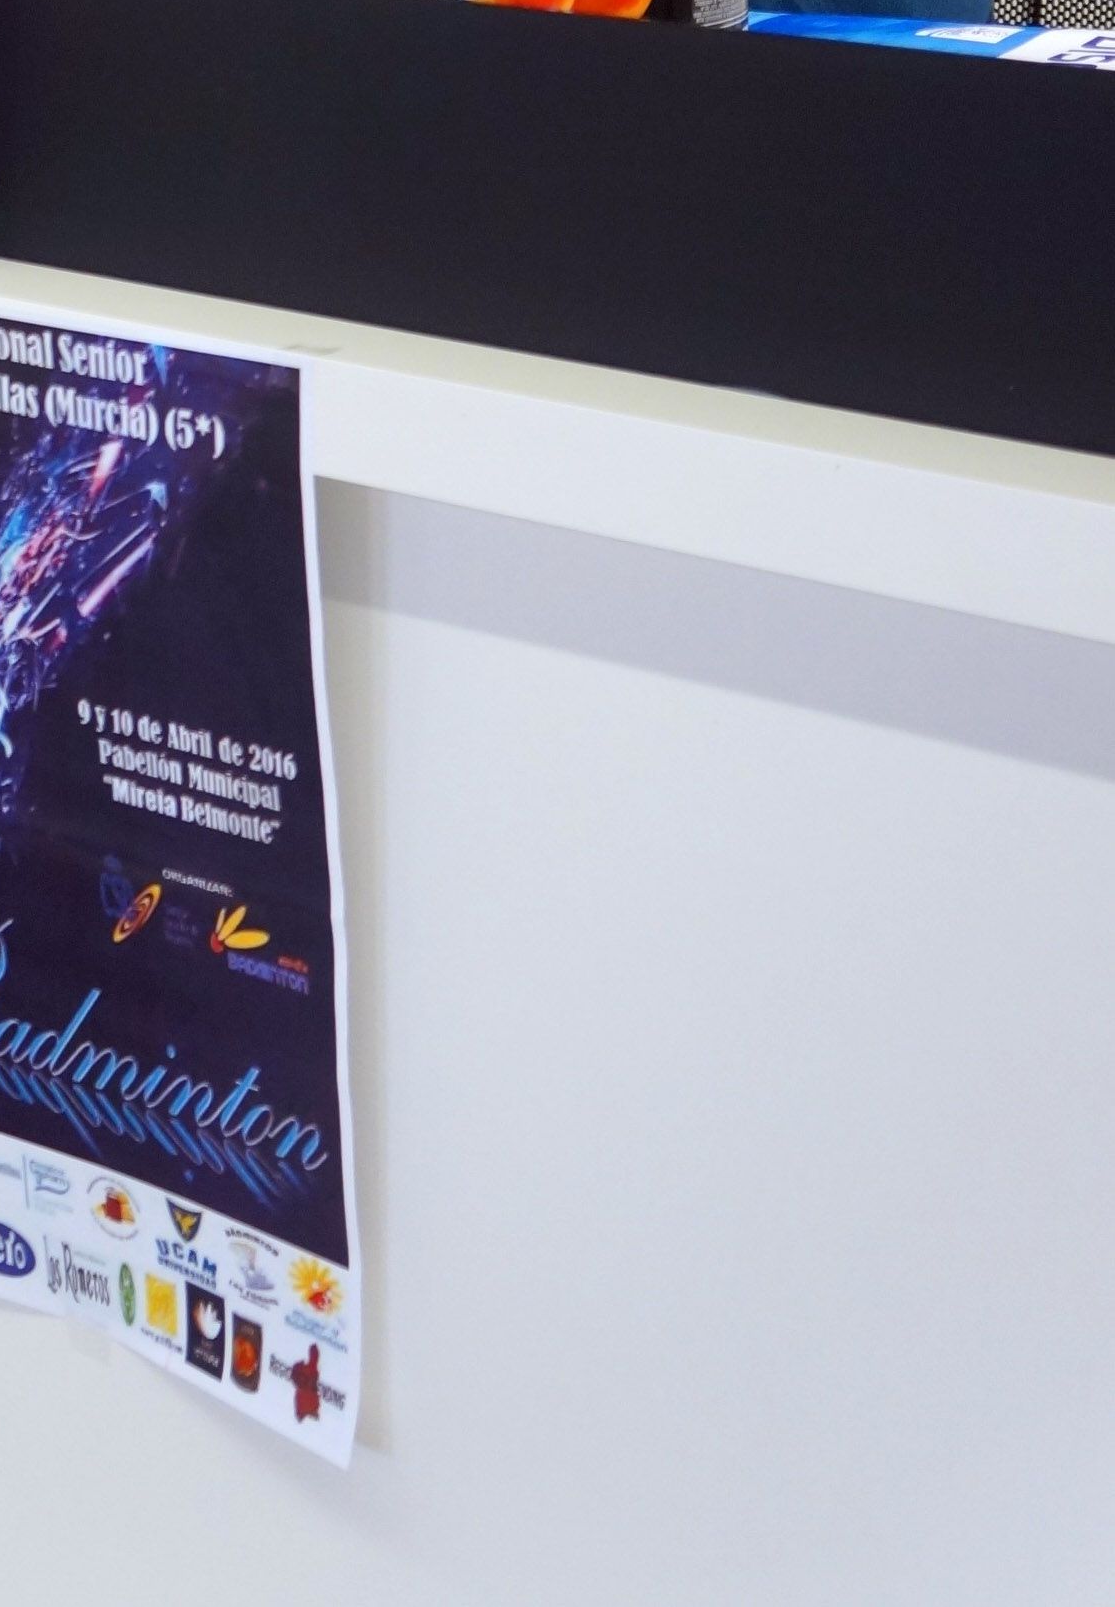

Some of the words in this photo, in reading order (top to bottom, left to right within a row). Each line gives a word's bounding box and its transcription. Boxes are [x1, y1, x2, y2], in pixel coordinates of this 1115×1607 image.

[59, 333, 149, 386] Senior
[45, 384, 159, 446] (Murcia)
[77, 698, 91, 725] 9
[94, 705, 106, 733] y
[111, 709, 133, 737] 10
[137, 714, 163, 744] de
[168, 721, 213, 759] Abril
[218, 736, 245, 766] de
[248, 743, 298, 781] 2016
[98, 738, 183, 785] Pabellón
[187, 761, 281, 812] Municipal
[155, 1238, 217, 1277] UCAM
